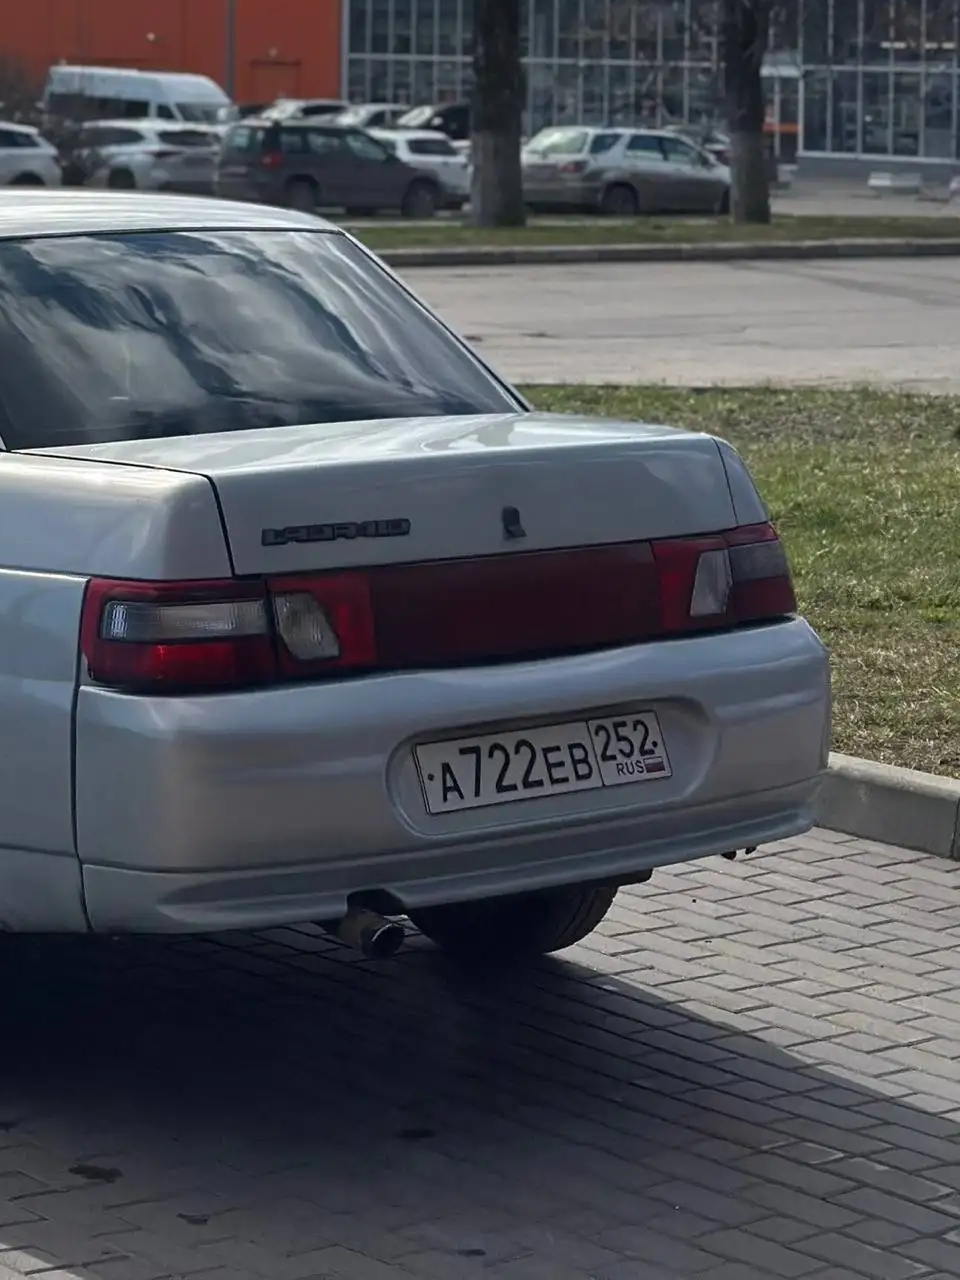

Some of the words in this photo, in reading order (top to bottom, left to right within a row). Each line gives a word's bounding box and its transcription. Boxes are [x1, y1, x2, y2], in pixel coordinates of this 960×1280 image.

[441, 738, 593, 802] A722EB
[594, 720, 655, 762] 252
[616, 762, 645, 776] RUS
